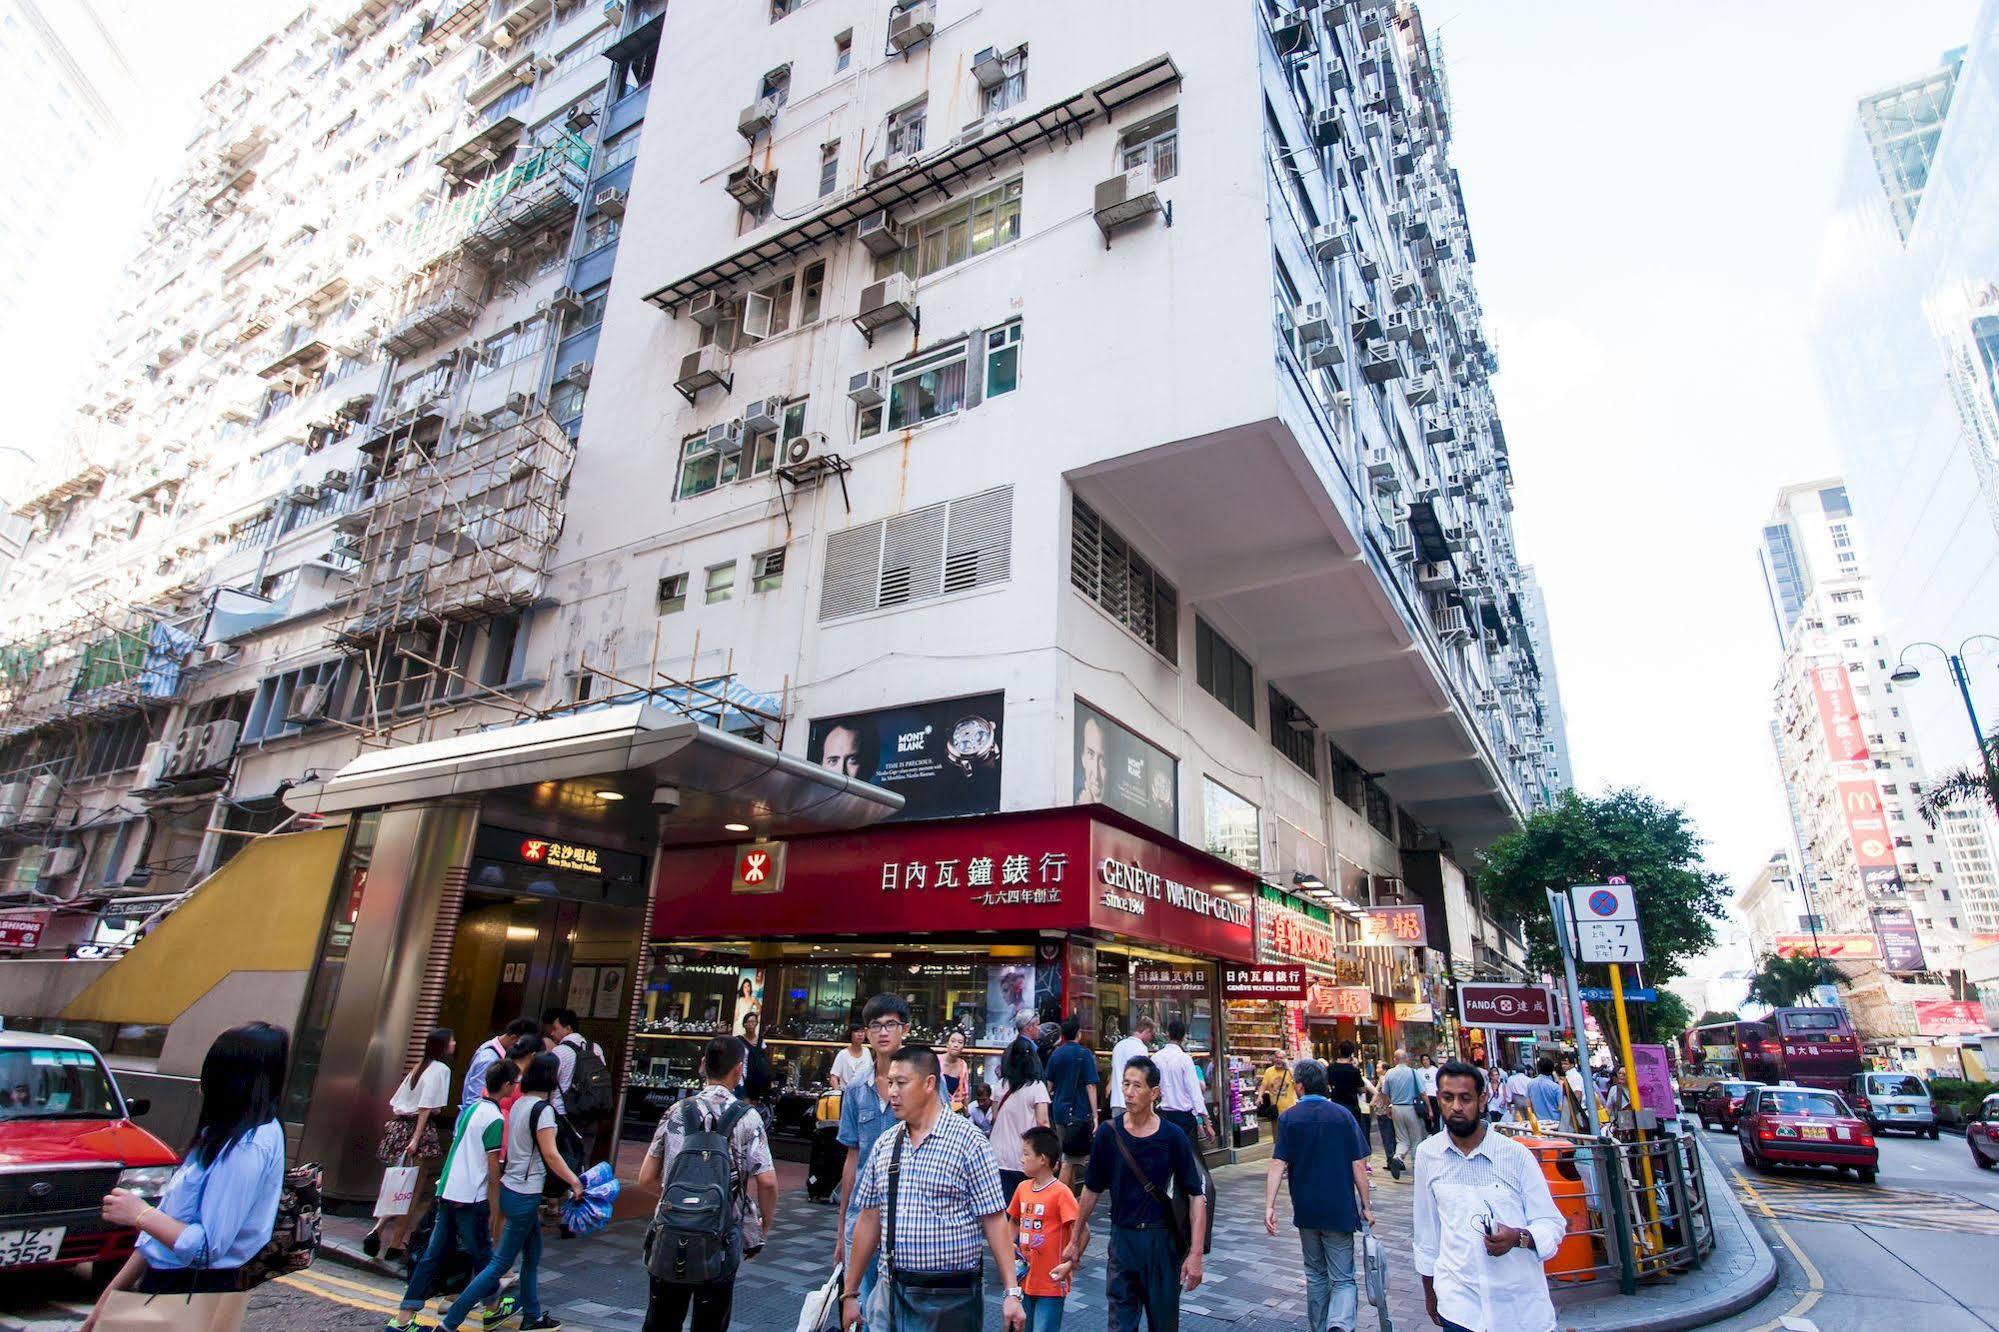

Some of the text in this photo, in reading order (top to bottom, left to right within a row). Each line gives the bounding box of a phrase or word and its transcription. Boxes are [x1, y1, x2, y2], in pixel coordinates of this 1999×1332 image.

[898, 731, 925, 744] MONT
[897, 741, 925, 753] BLANC
[548, 843, 598, 864] 尖沙咀站
[971, 888, 1061, 906] 一九六四年創立
[1105, 889, 1145, 915] since 1964
[1165, 878, 1210, 916] WATCH
[1212, 896, 1251, 928] CENTRE
[1615, 924, 1625, 937] 7
[1618, 945, 1629, 957] 7
[1466, 1000, 1497, 1010] FANDA
[10, 1229, 41, 1247] JZ
